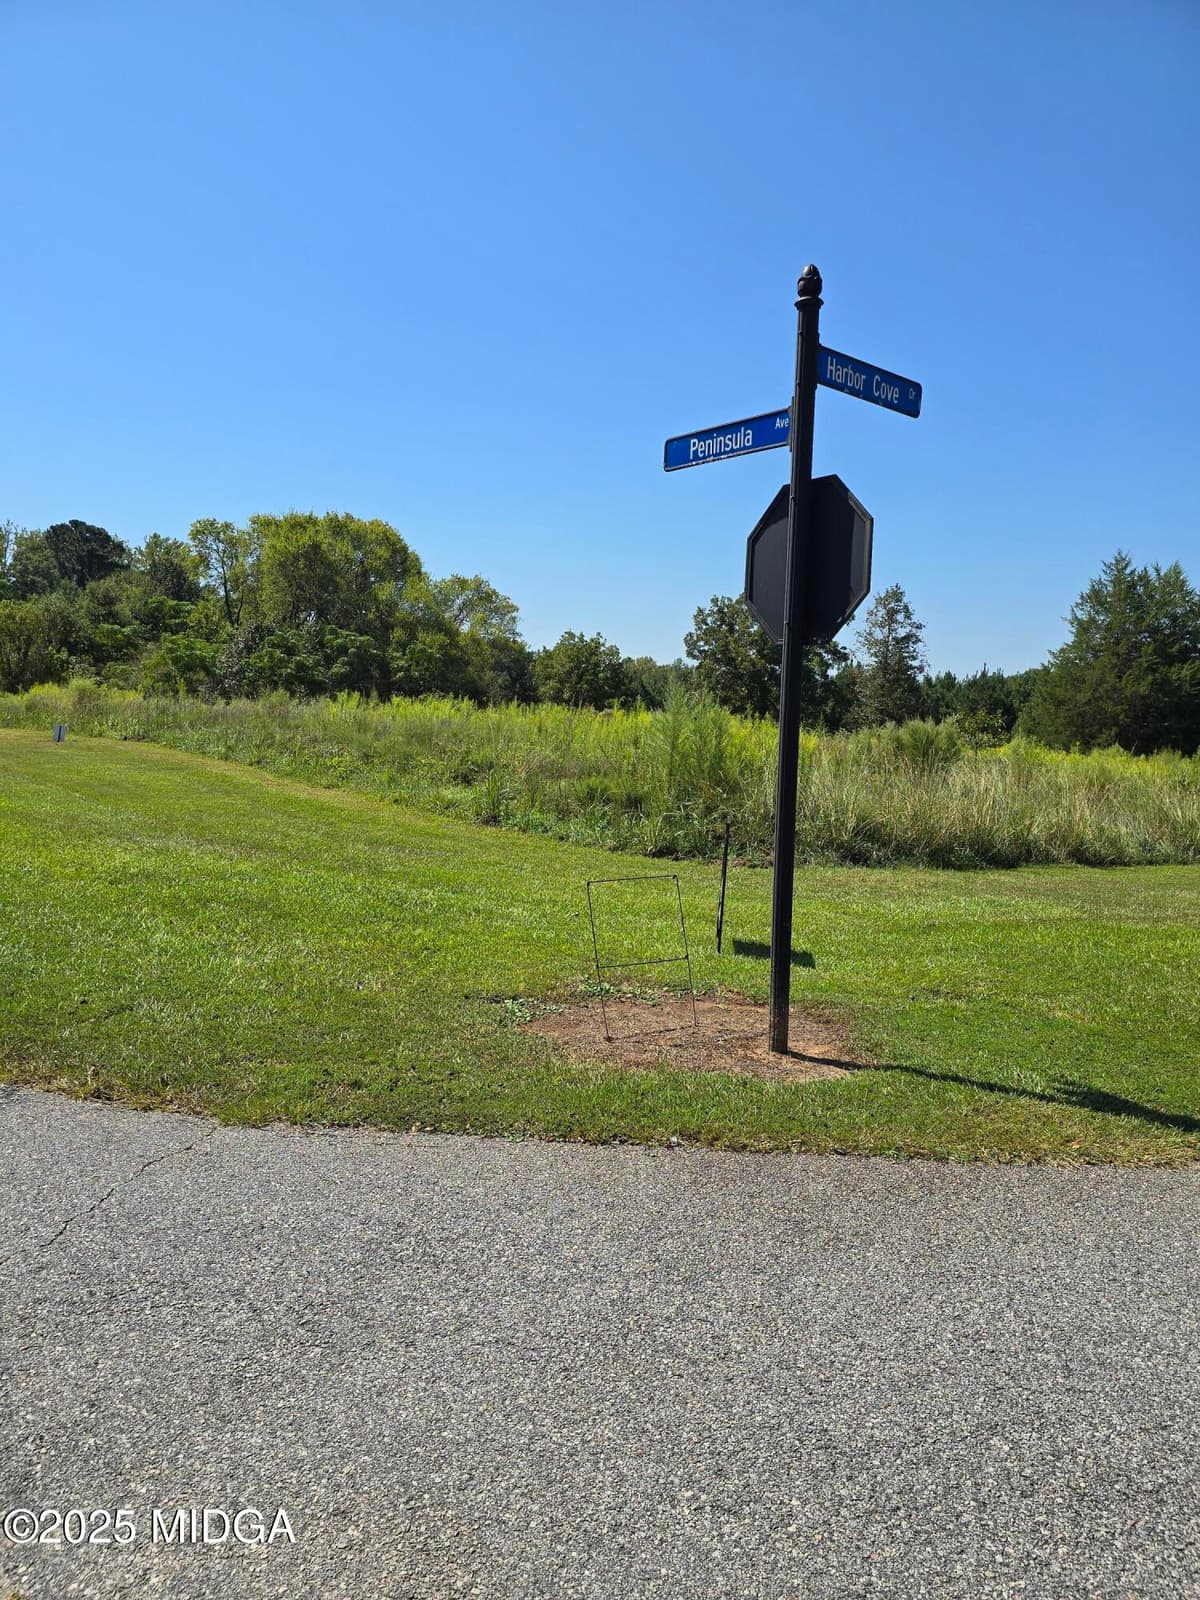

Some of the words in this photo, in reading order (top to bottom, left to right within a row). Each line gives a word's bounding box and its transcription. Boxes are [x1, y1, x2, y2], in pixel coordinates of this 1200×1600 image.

[827, 356, 866, 391] Harbor
[873, 374, 900, 404] Cove
[908, 387, 916, 401] Dr
[689, 426, 753, 460] Peninsula
[775, 417, 790, 430] Ave
